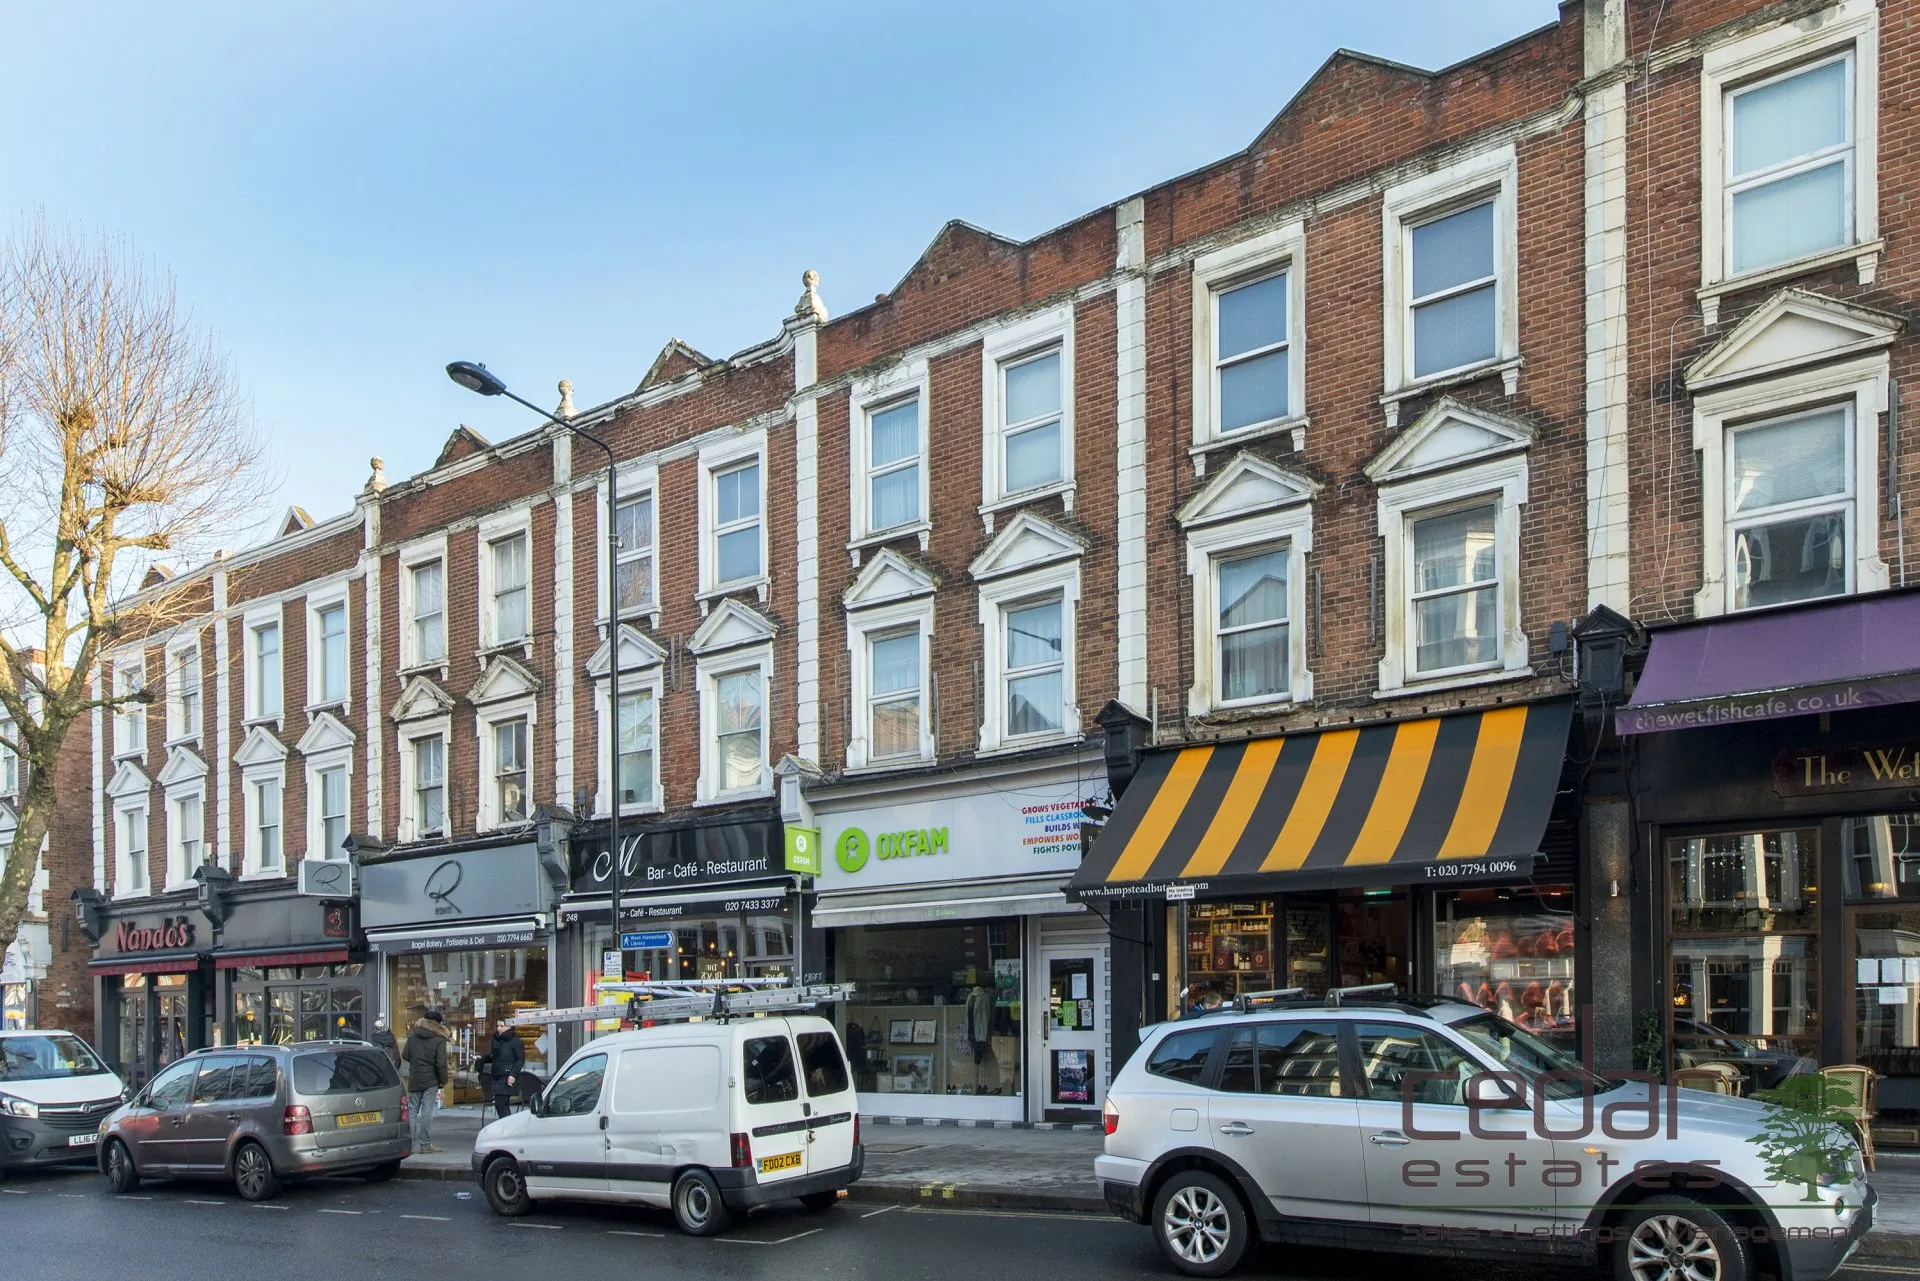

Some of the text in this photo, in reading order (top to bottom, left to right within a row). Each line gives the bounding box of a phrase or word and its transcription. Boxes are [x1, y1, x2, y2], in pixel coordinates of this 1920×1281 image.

[1797, 755, 1851, 787] The
[1022, 804, 1049, 815] GROWS
[1025, 815, 1044, 825] FILLS
[1044, 822, 1071, 833] BUILDS
[876, 826, 949, 860] OXFAM
[1022, 834, 1064, 846] EMPOWERS
[1033, 846, 1060, 855] FIGHTS
[793, 855, 810, 866] OXFAM
[647, 866, 665, 881] Bar
[673, 861, 698, 878] Café
[706, 856, 768, 875] Restaurant
[1438, 865, 1458, 877] 020
[1460, 863, 1487, 875] 7794
[1489, 860, 1517, 873] 0096
[725, 898, 780, 912] 020 7433 3377
[566, 913, 578, 922] 248
[630, 906, 644, 918] Café
[648, 906, 682, 917] Restaurant
[114, 920, 188, 953] Nando's
[496, 932, 533, 943] 020 7794 6663
[642, 933, 667, 941] Hampstead
[411, 941, 426, 950] Bagel
[426, 939, 443, 949] Bakery
[446, 937, 468, 947] Patisserie
[474, 936, 485, 945] Deli
[73, 1135, 91, 1144] LL16
[763, 1153, 801, 1171] FD02 CXB
